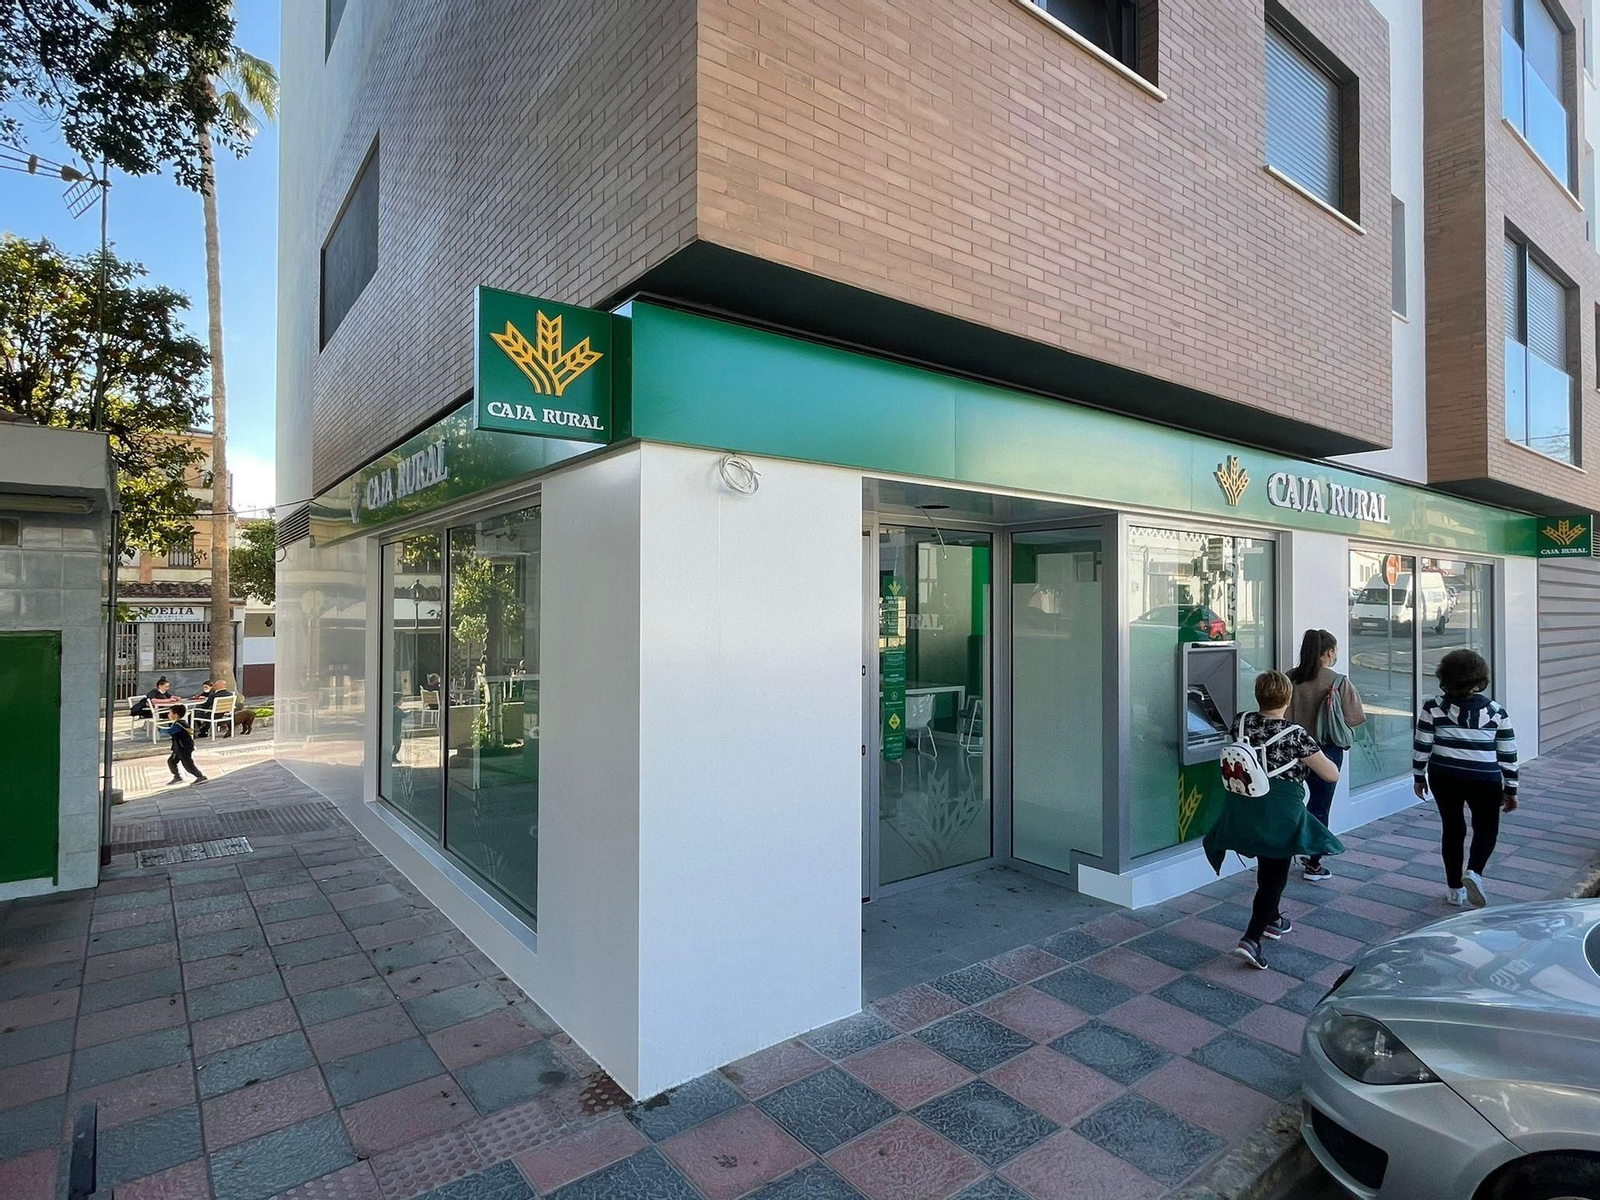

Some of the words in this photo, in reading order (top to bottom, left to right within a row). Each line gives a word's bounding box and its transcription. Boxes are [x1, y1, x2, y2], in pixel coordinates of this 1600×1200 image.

[487, 401, 537, 421] CAJA
[542, 408, 604, 431] RURAL
[366, 467, 394, 510] CAJA
[396, 439, 448, 499] RURAL
[1267, 472, 1326, 513] CAJA
[1327, 482, 1390, 524] RURAL
